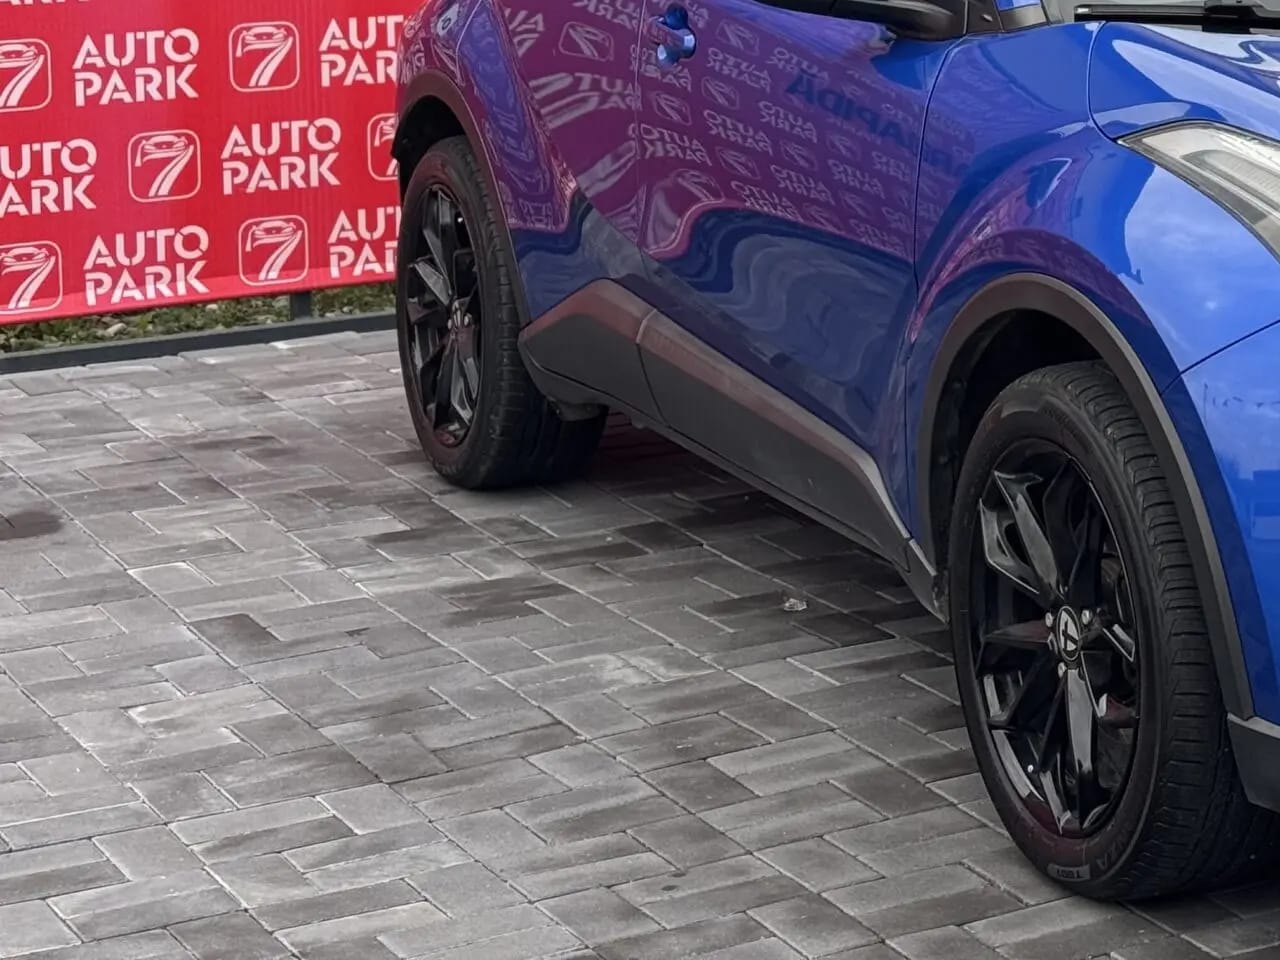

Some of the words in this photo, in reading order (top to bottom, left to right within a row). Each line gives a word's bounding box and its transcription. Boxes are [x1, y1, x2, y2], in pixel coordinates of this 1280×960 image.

[73, 28, 199, 69] AUTO
[319, 14, 402, 52] AUT
[75, 64, 197, 106] PARK
[0, 139, 96, 179] UTO
[222, 118, 341, 159] AUTO
[223, 153, 340, 194] PARK
[0, 175, 96, 218] ARK
[84, 225, 208, 269] AUTO
[85, 261, 209, 306] PARK
